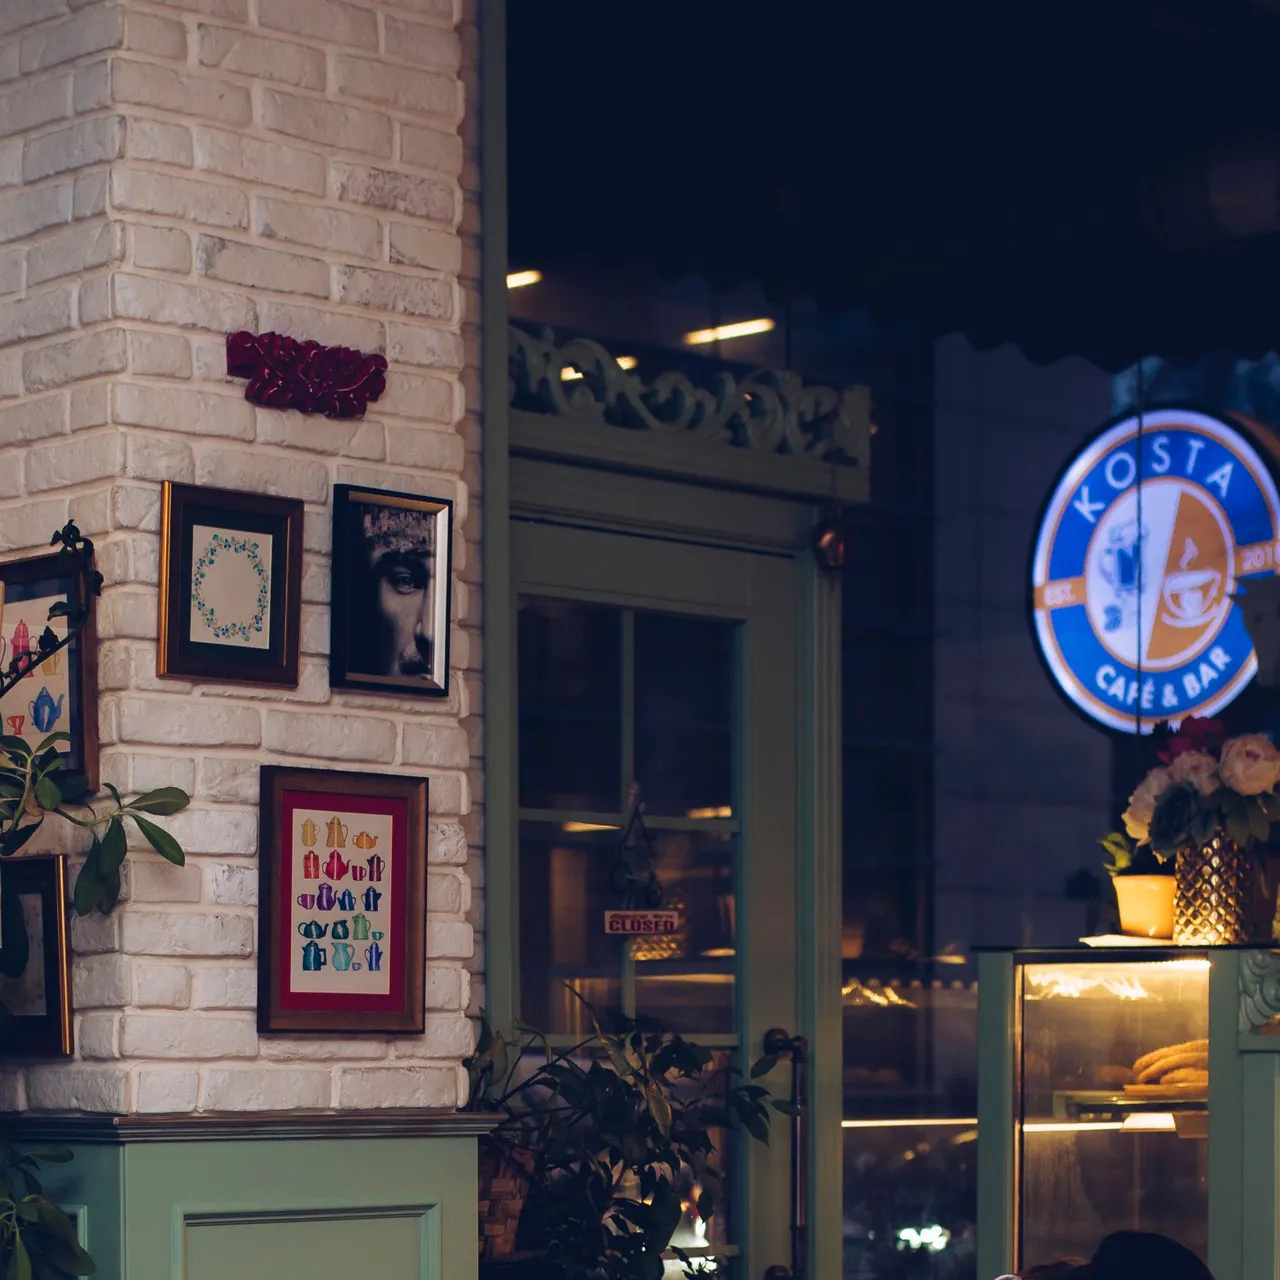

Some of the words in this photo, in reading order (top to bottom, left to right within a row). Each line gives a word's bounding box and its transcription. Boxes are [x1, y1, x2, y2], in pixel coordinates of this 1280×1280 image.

[1073, 435, 1235, 524] KOSTA
[1095, 664, 1154, 709] CAFÉ
[1162, 684, 1179, 708] &
[1182, 646, 1232, 700] BAR
[608, 919, 675, 932] CLOSED
